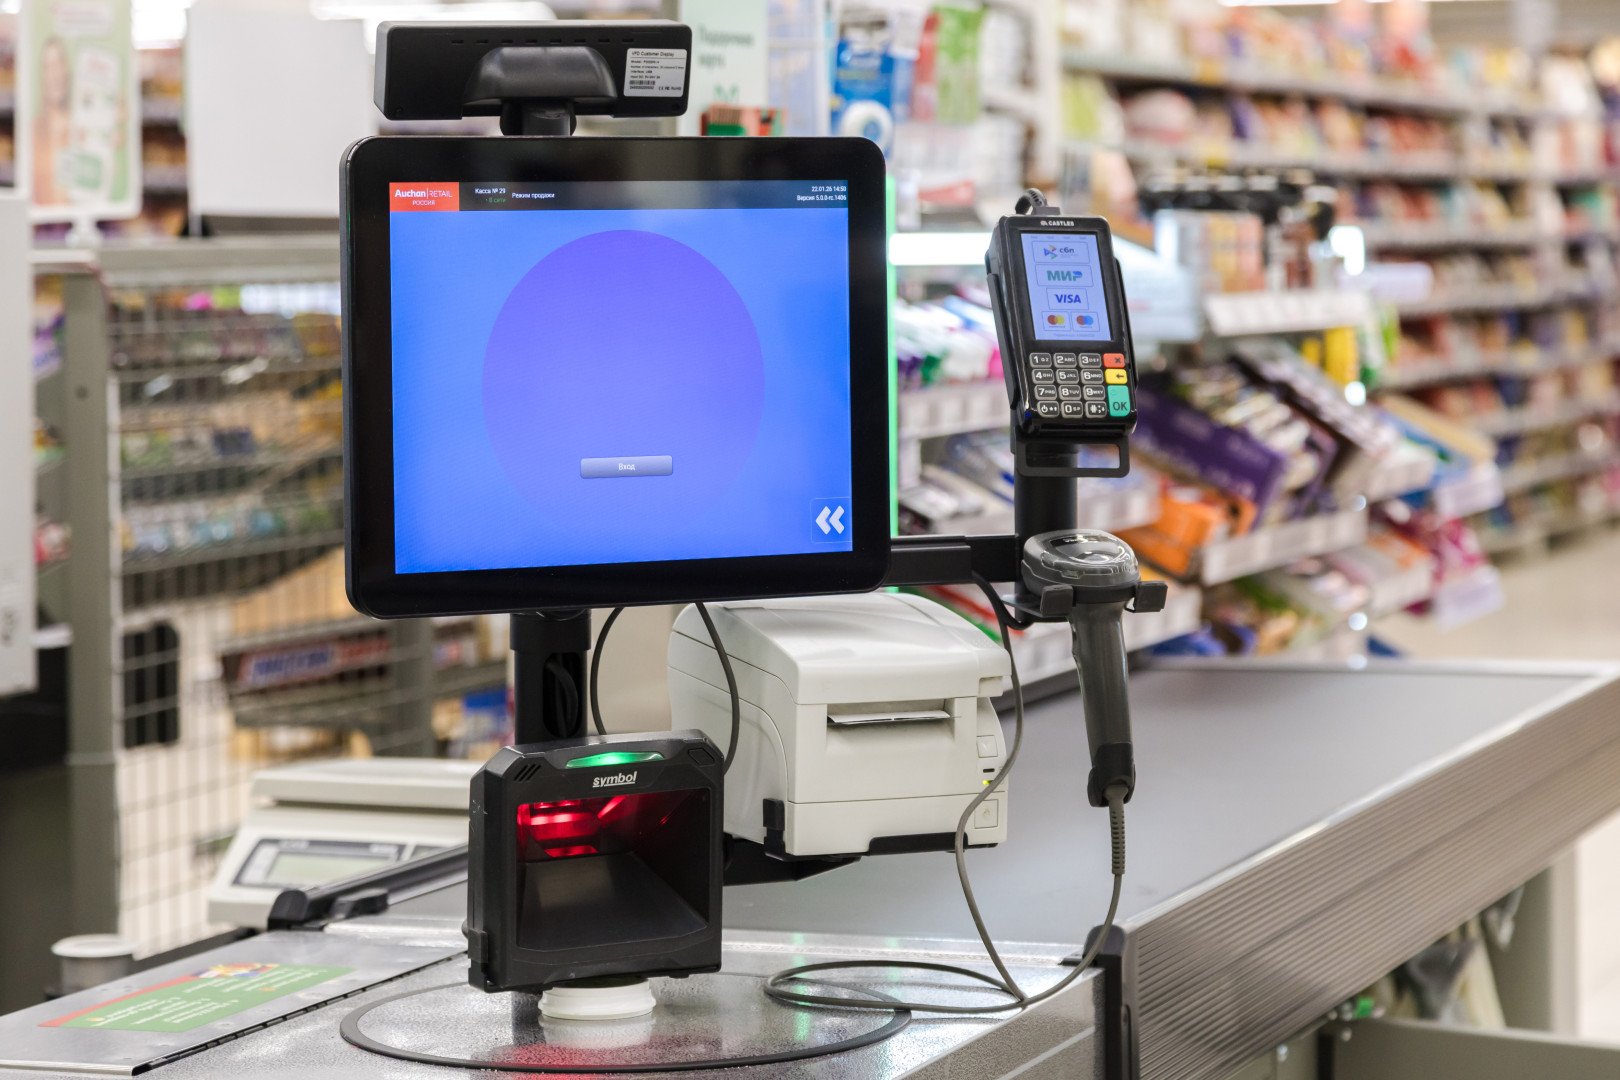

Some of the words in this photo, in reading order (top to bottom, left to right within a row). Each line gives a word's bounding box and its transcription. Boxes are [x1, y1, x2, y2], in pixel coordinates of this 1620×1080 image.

[394, 189, 426, 198] Auchan
[428, 190, 453, 198] RETAIL
[1047, 270, 1083, 281] МИР
[1054, 294, 1081, 304] VISA
[1033, 355, 1039, 364] 1
[1056, 355, 1064, 364] 2
[1082, 356, 1089, 364] 3
[1035, 371, 1043, 379] 4
[1059, 371, 1067, 379] 5
[1084, 371, 1091, 380] 6
[1038, 388, 1045, 396] 7
[1061, 388, 1069, 396] 8
[1086, 388, 1093, 396] 9
[1112, 401, 1127, 411] OK
[618, 462, 636, 471] Вход
[592, 770, 638, 788] symbol
